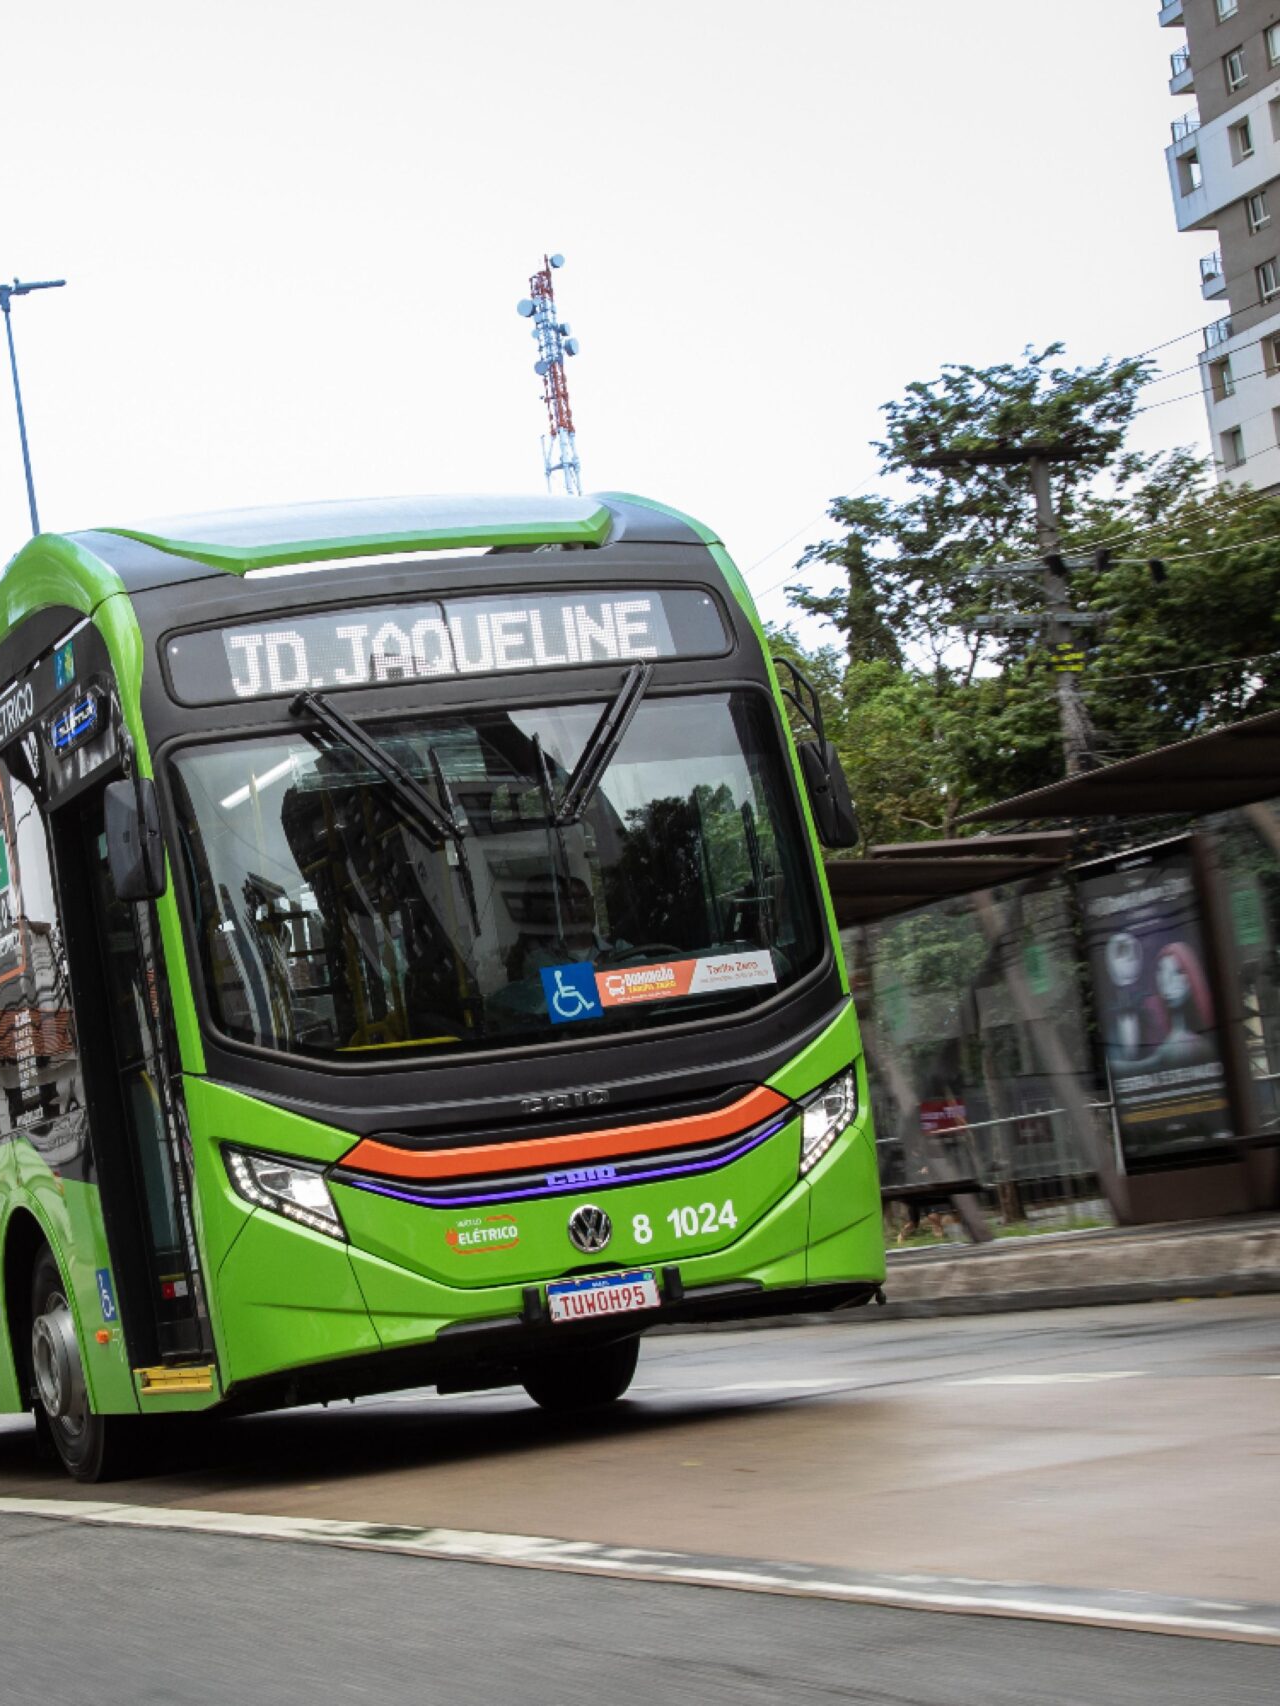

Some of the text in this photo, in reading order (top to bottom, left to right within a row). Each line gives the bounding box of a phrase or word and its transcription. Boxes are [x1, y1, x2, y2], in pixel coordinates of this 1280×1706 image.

[335, 599, 657, 682] JAQUELINE
[545, 1166, 617, 1187] CAIO
[458, 1226, 518, 1246] ELÉTRICO
[632, 1199, 738, 1244] 8 1024
